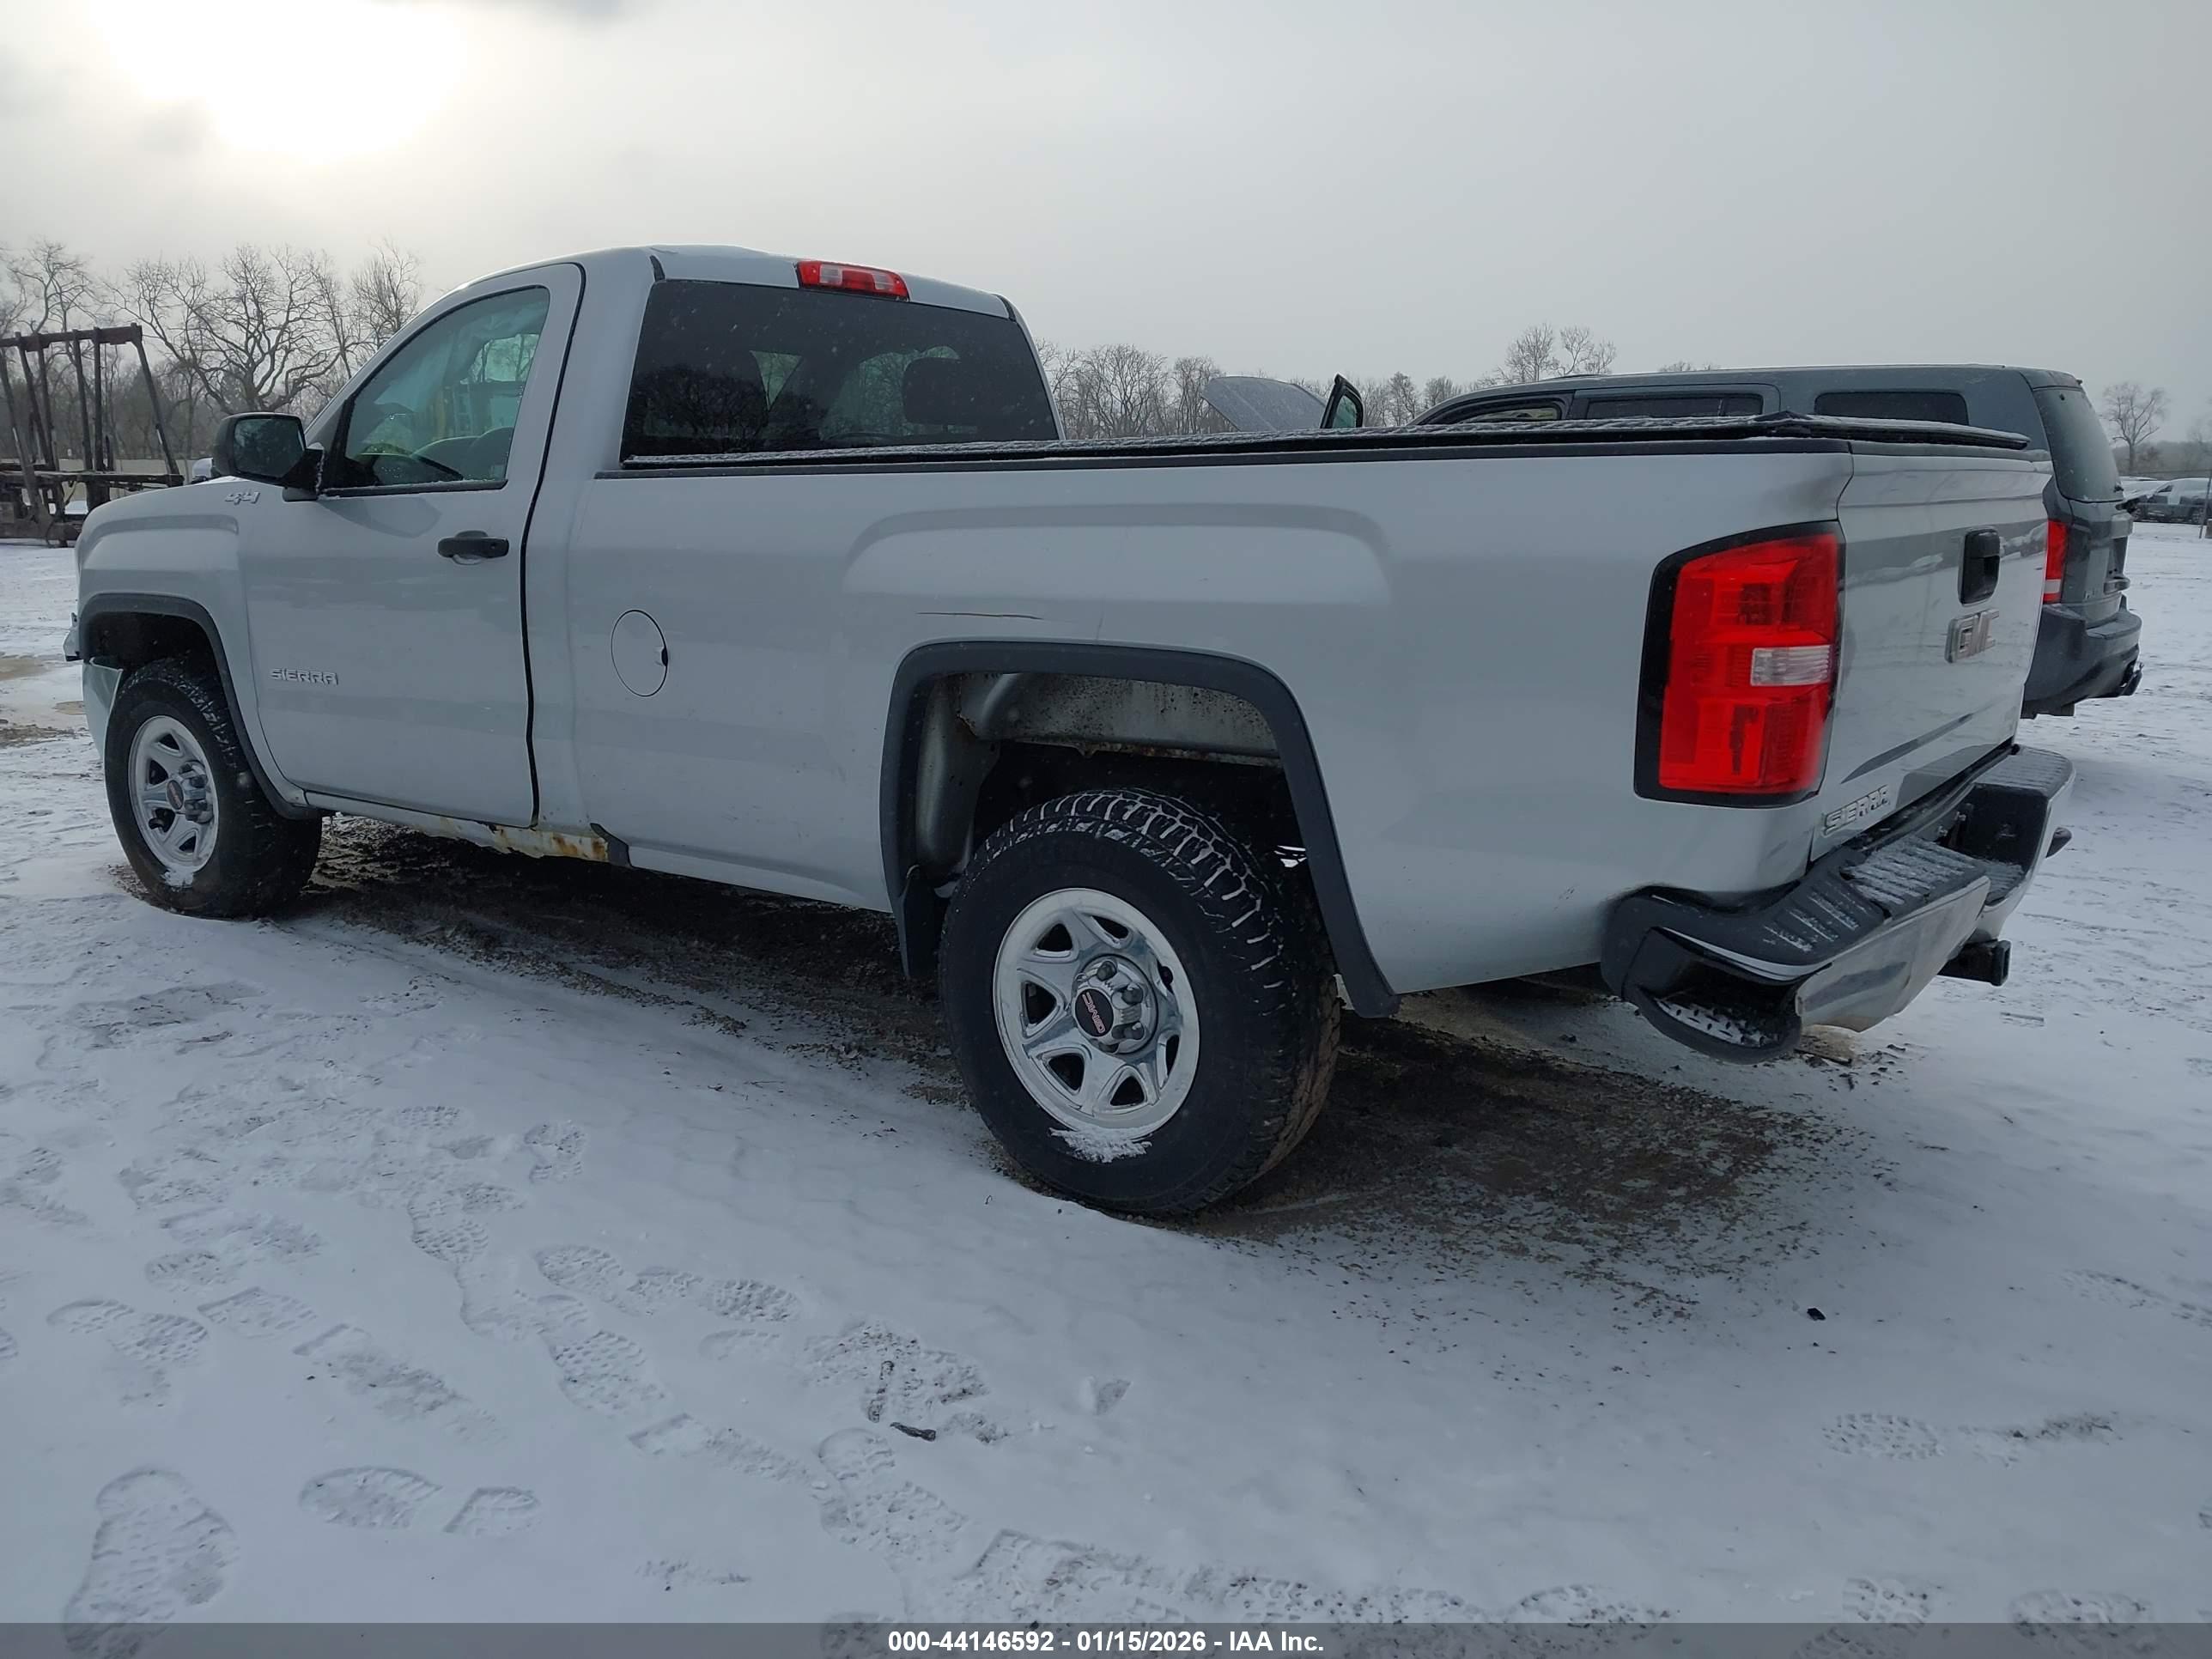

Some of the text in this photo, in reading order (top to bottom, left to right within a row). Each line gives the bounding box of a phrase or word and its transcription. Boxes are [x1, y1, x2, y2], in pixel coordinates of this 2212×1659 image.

[270, 668, 338, 685] SIERRA
[1821, 785, 1891, 836] SIERRA
[1082, 992, 1106, 1034] GMC
